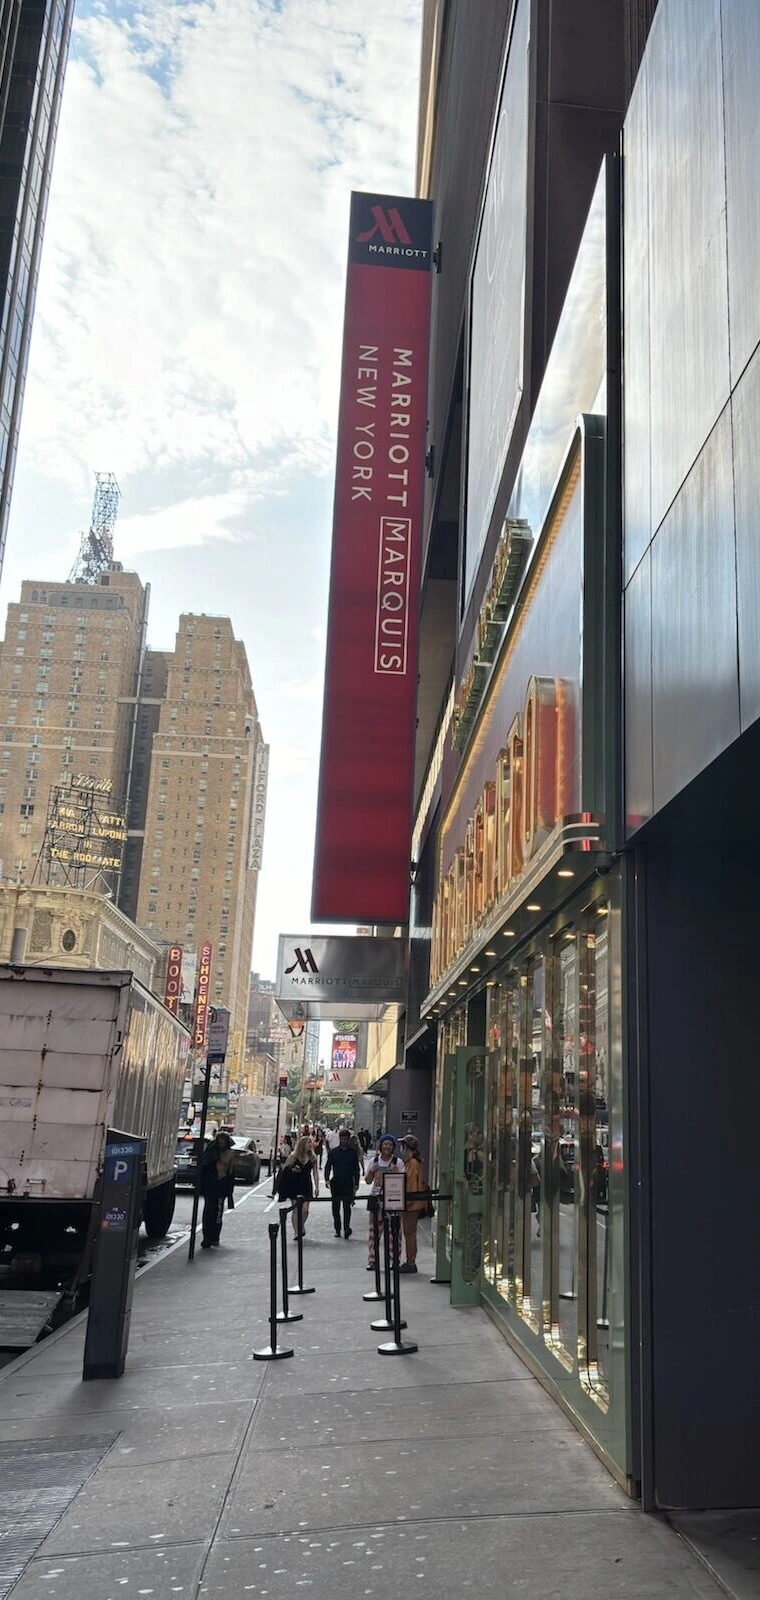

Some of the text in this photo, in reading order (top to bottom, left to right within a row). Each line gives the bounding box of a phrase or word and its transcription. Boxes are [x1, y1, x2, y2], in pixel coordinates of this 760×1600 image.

[368, 245, 428, 258] MARRIOTT
[351, 345, 379, 501] NEW YORK
[379, 348, 413, 669] MARRIOTT MARQUIS
[92, 827, 128, 841] LUPONE
[250, 818, 262, 868] PLAZA
[50, 848, 69, 860] THE
[167, 949, 180, 1009] BOOT
[195, 947, 210, 1044] SCHOENFELD
[291, 977, 400, 987] MARRIOTT MARQUIS
[113, 1161, 128, 1181] P
